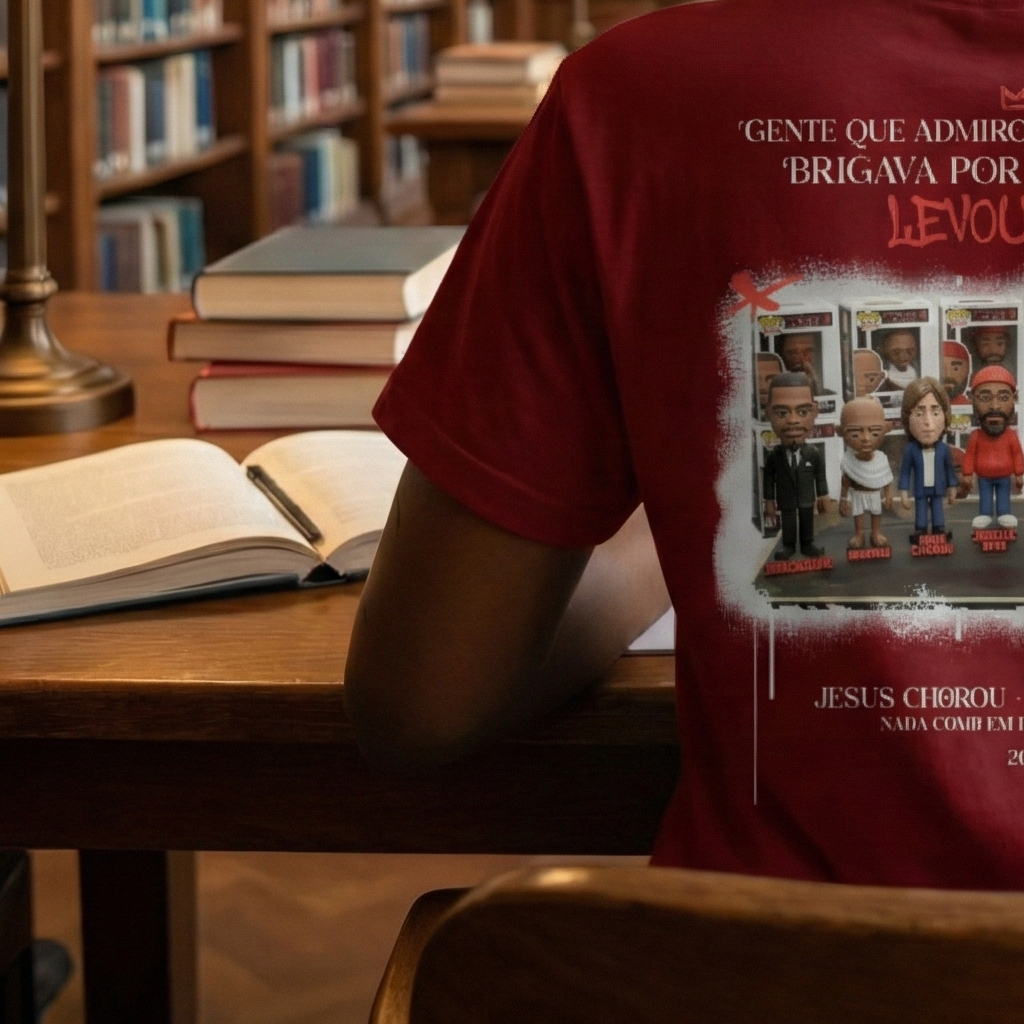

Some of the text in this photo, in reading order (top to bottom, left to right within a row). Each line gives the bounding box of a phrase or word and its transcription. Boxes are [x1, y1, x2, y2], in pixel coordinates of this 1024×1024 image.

[845, 118, 906, 149] QUE
[782, 155, 938, 185] BRIGAVA
[950, 155, 1022, 185] POR
[814, 686, 895, 709] JESUS
[902, 686, 1006, 709] CHOROU
[880, 716, 928, 732] NADA
